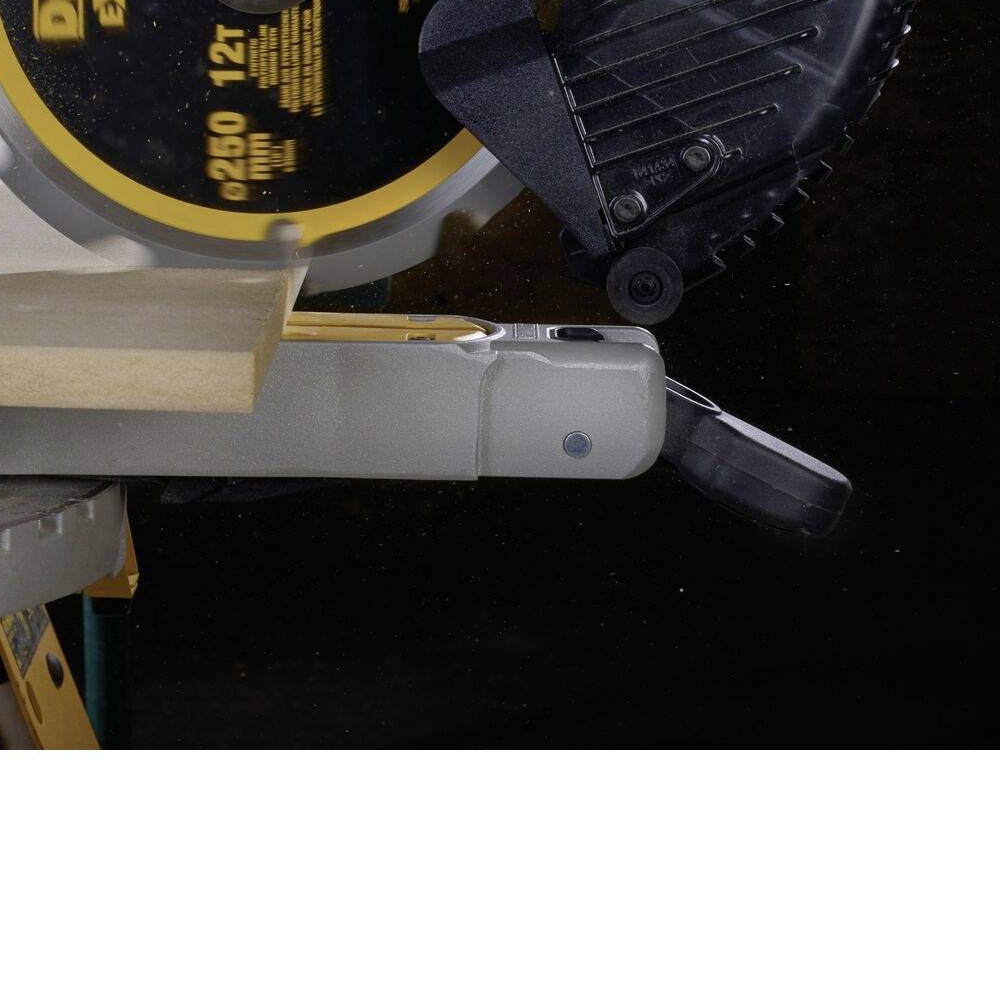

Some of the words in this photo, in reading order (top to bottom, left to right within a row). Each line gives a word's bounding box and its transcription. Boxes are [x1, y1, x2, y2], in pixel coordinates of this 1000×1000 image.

[207, 24, 247, 87] 12T
[249, 38, 258, 77] SYNTHETIC
[269, 27, 278, 50] TEETH
[269, 52, 278, 85] DIAMOND
[248, 133, 273, 180] mm
